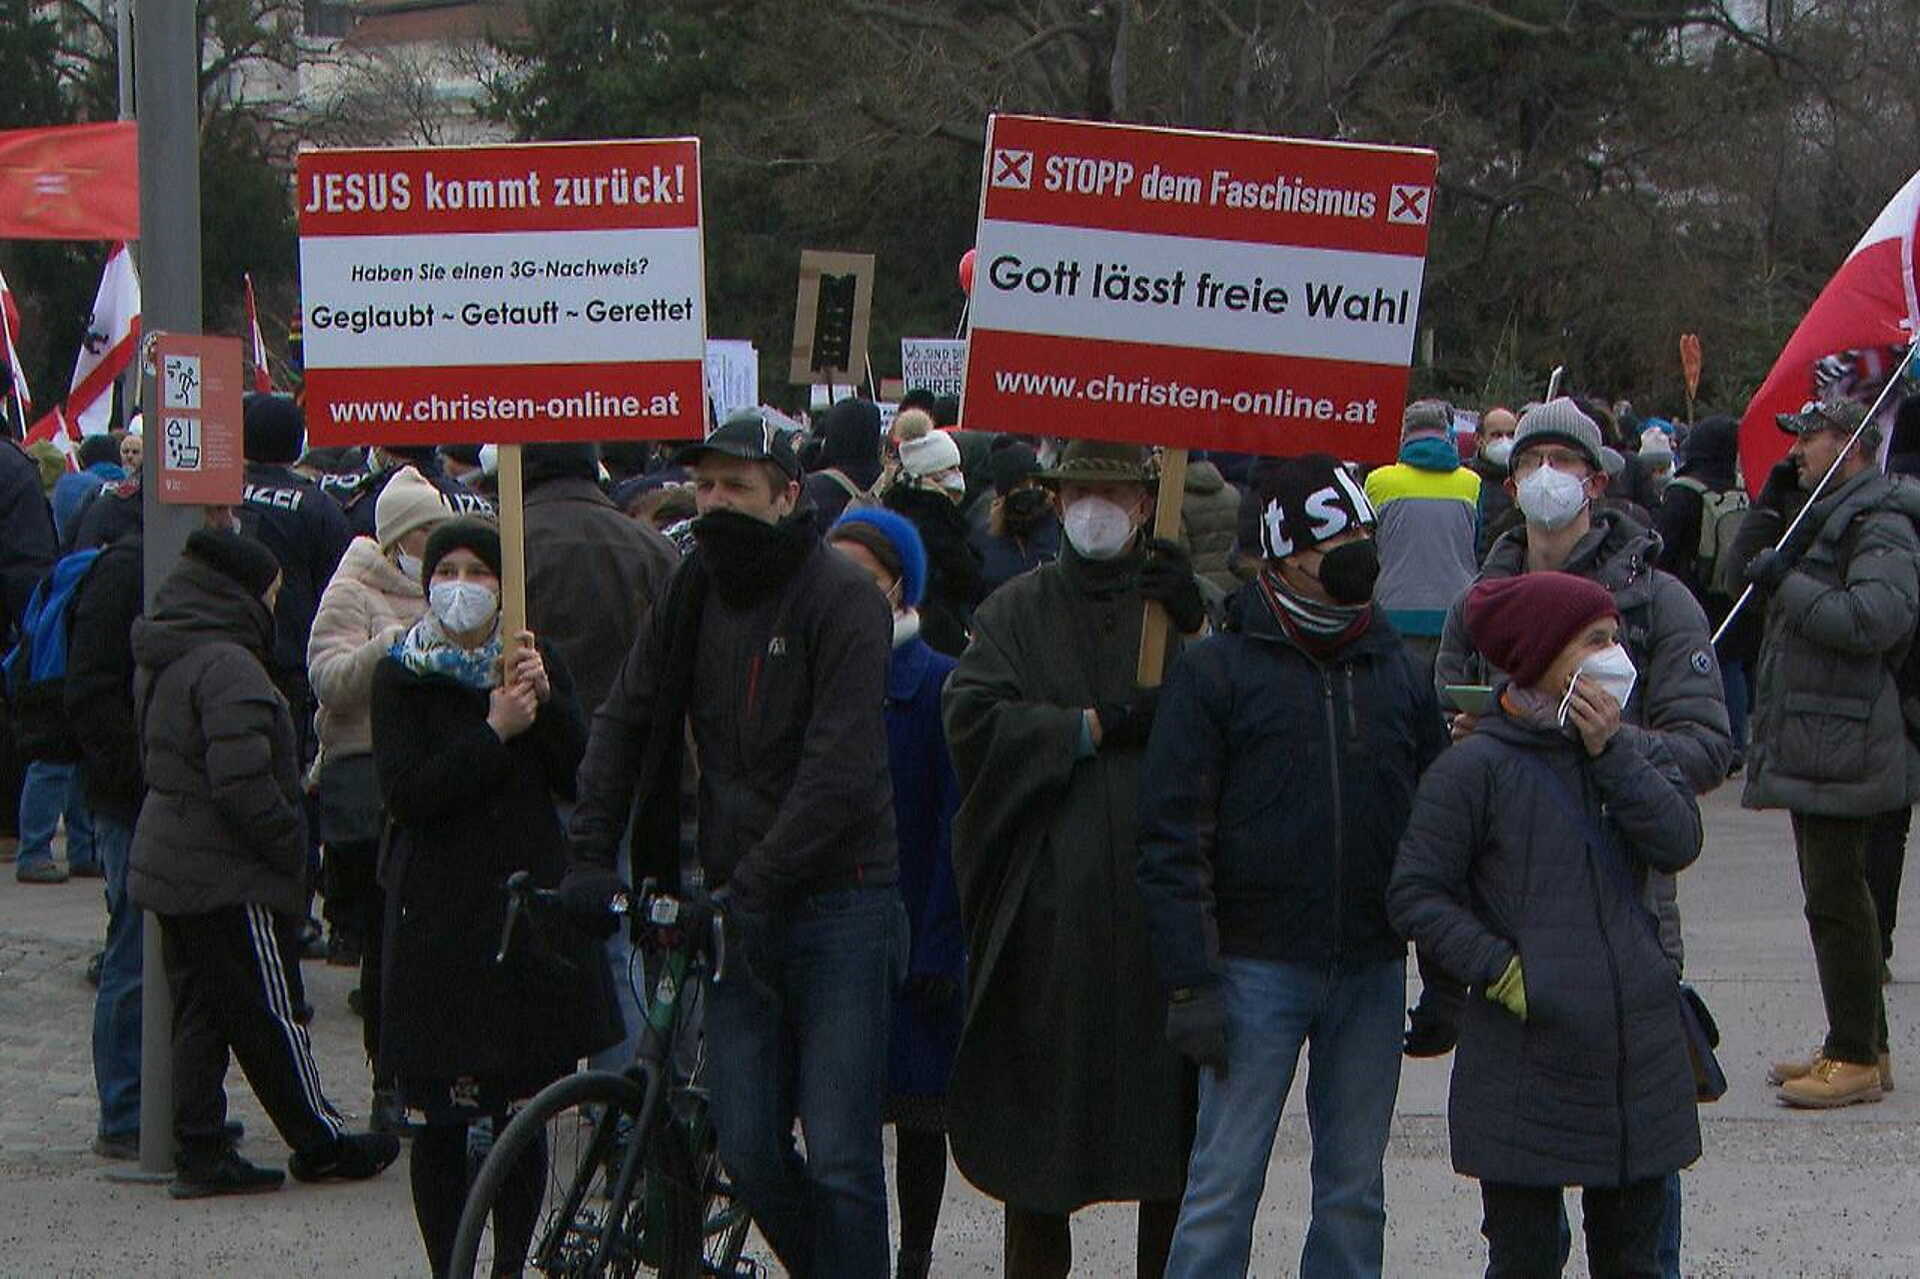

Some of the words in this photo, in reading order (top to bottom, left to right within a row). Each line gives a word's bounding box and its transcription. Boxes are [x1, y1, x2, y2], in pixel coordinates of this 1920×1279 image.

[304, 171, 411, 214] JESUS
[425, 170, 541, 210] kommt
[553, 164, 685, 207] zurück!
[1044, 156, 1134, 197] STOPP
[1141, 165, 1201, 204] dem
[1209, 171, 1377, 219] Faschismus
[351, 263, 413, 282] Haben
[419, 262, 446, 281] Sie
[452, 261, 504, 280] einen
[510, 257, 649, 279] 3G-Nachweis?
[989, 254, 1081, 297] Gott
[1093, 264, 1185, 306] lässt
[1196, 273, 1289, 313] freie
[1304, 282, 1409, 325] Wahl
[311, 303, 434, 334] Geglaubt
[461, 300, 559, 327] Getauft
[585, 297, 693, 324] Gerettet
[329, 391, 680, 424] www.christen-online.at
[994, 369, 1379, 425] www.christen-online.at
[242, 483, 303, 511] IZEI
